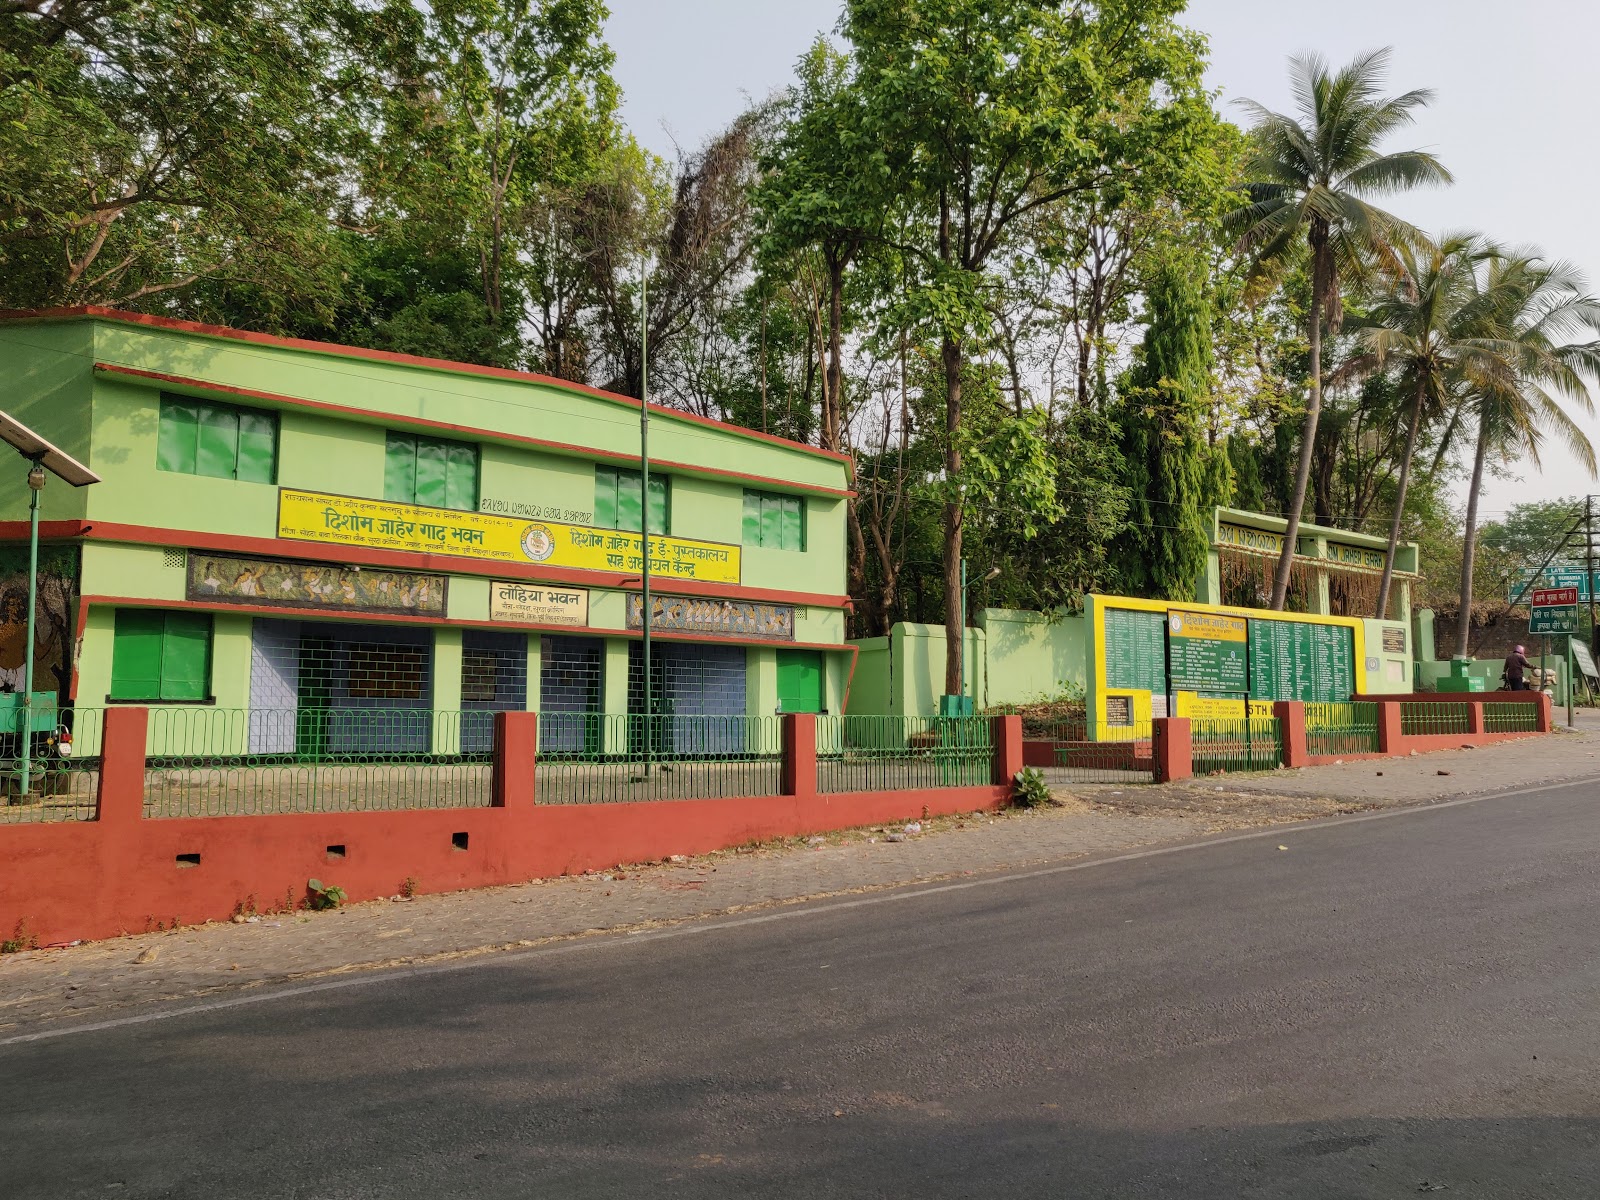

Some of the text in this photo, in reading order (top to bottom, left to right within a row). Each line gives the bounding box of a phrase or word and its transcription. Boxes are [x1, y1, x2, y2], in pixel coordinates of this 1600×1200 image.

[320, 507, 486, 545] दिशोम जाहेर गाढ़ भवन
[569, 528, 604, 549] दिशोम
[605, 533, 631, 552] जाहेर
[671, 544, 729, 563] पुस्तकालय
[606, 553, 624, 569] सह
[498, 585, 581, 605] लोहिया भवन
